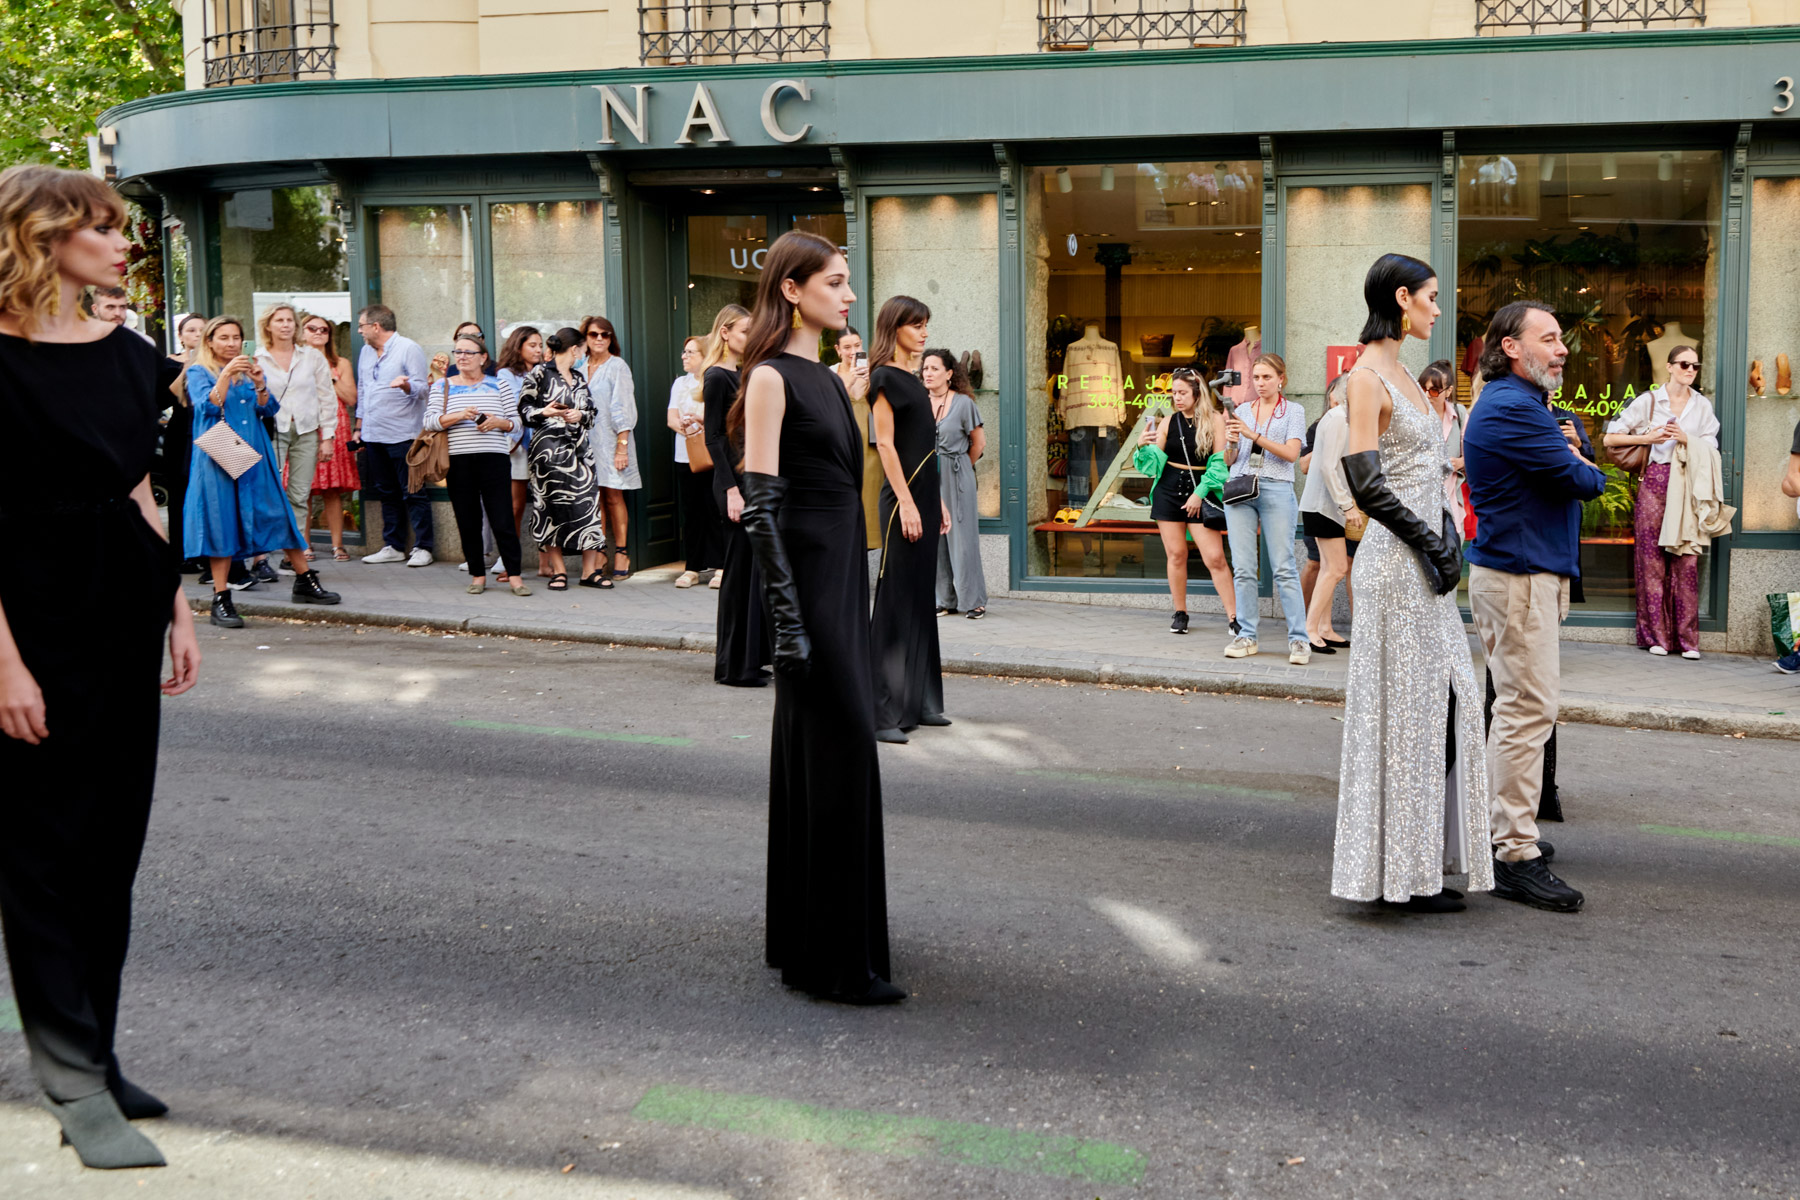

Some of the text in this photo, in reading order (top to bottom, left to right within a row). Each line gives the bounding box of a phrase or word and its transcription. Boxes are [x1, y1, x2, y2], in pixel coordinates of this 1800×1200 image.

[1772, 76, 1795, 112] 3
[591, 79, 814, 144] NAC
[1057, 374, 1173, 390] REBAJ
[1087, 393, 1171, 409] 30%-40%
